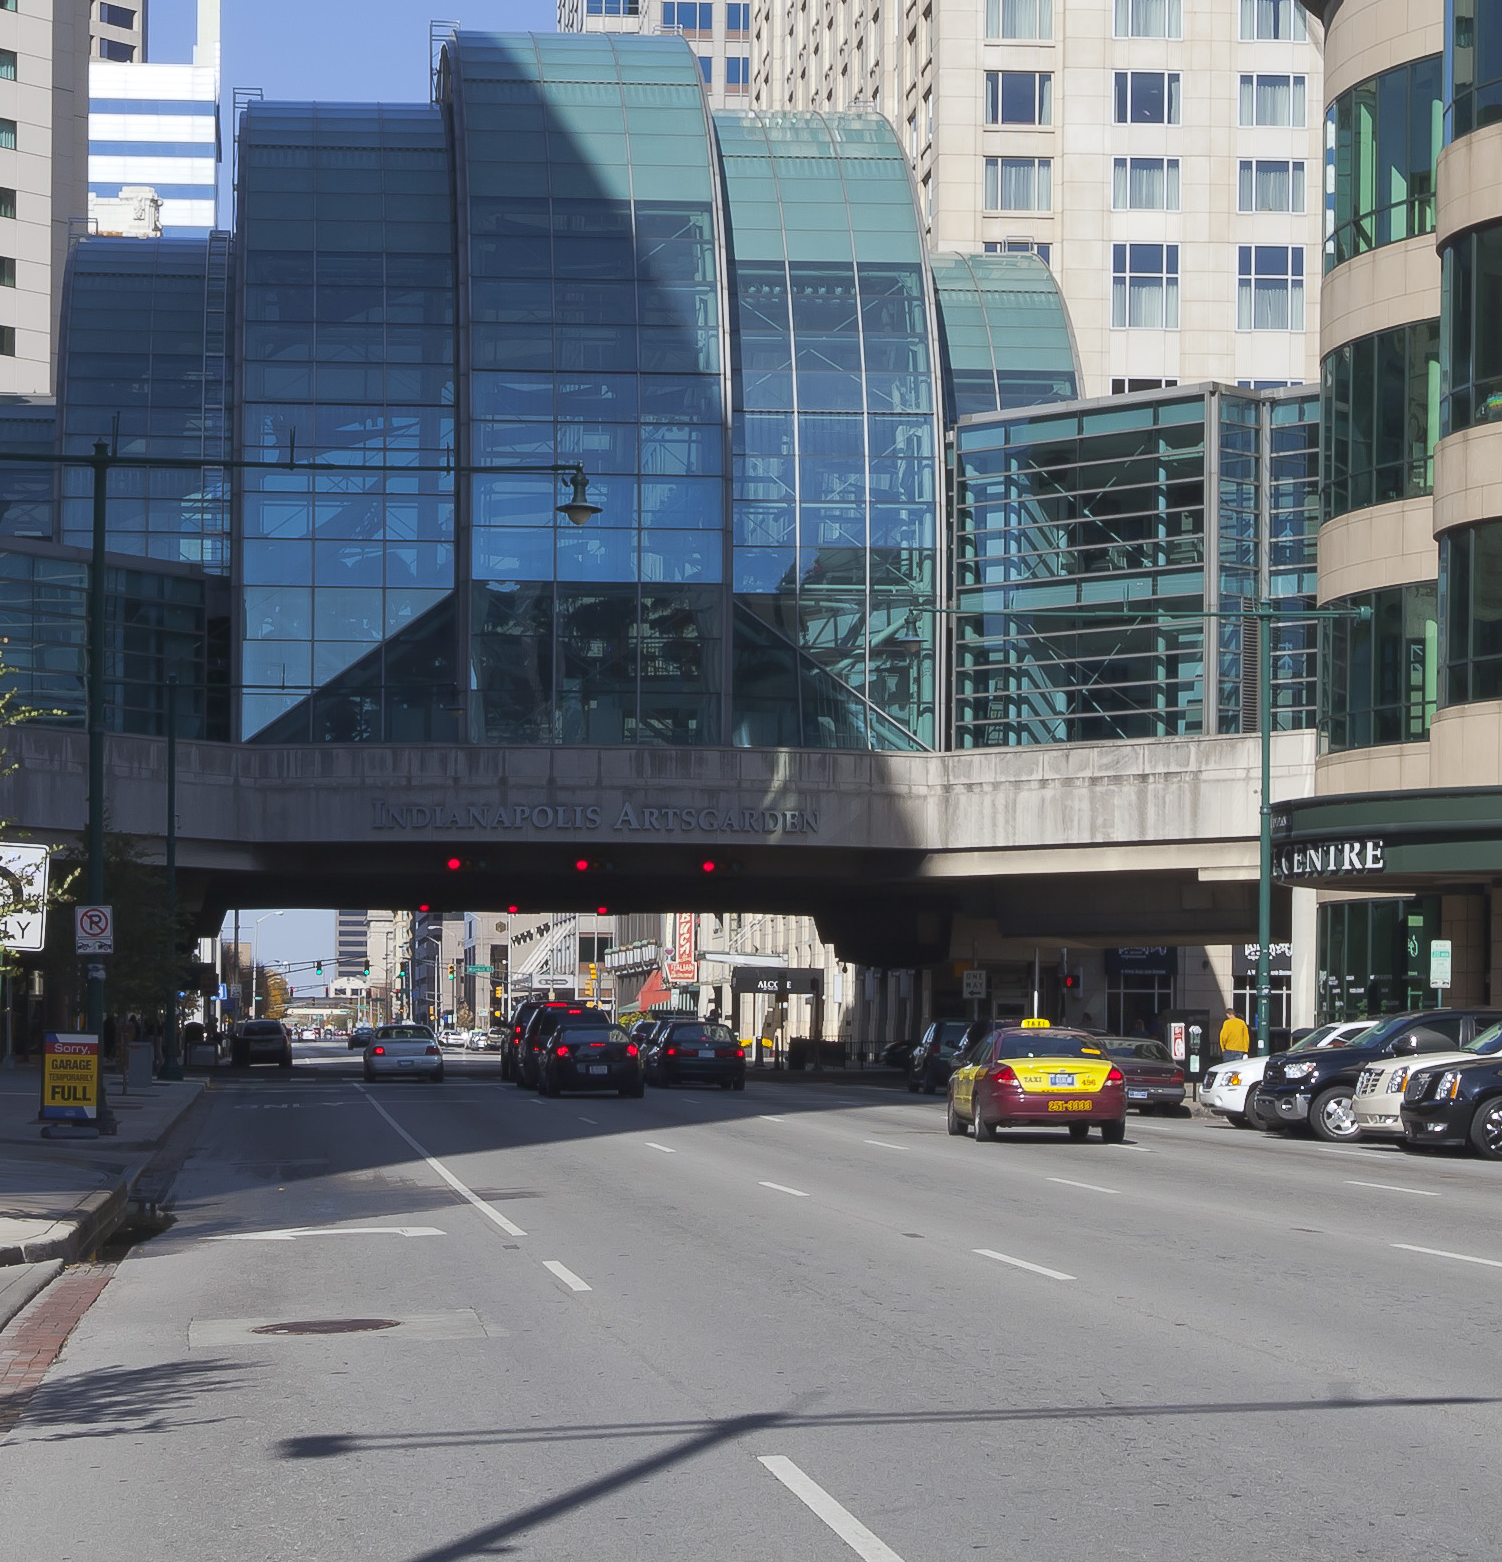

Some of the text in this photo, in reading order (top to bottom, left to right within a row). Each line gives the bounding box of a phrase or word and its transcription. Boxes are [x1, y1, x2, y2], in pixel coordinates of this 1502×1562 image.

[371, 799, 819, 833] INDIANAPOLIS ARTSGARDEN
[1281, 840, 1384, 875] CENTRE
[966, 972, 984, 981] ONE
[966, 981, 984, 989] WAY
[54, 1043, 91, 1055] Sorry,
[51, 1059, 92, 1070] GARAGE
[48, 1072, 94, 1082] TEMPORARILY
[51, 1085, 92, 1101] FULL
[1048, 1100, 1093, 1112] 251-3333
